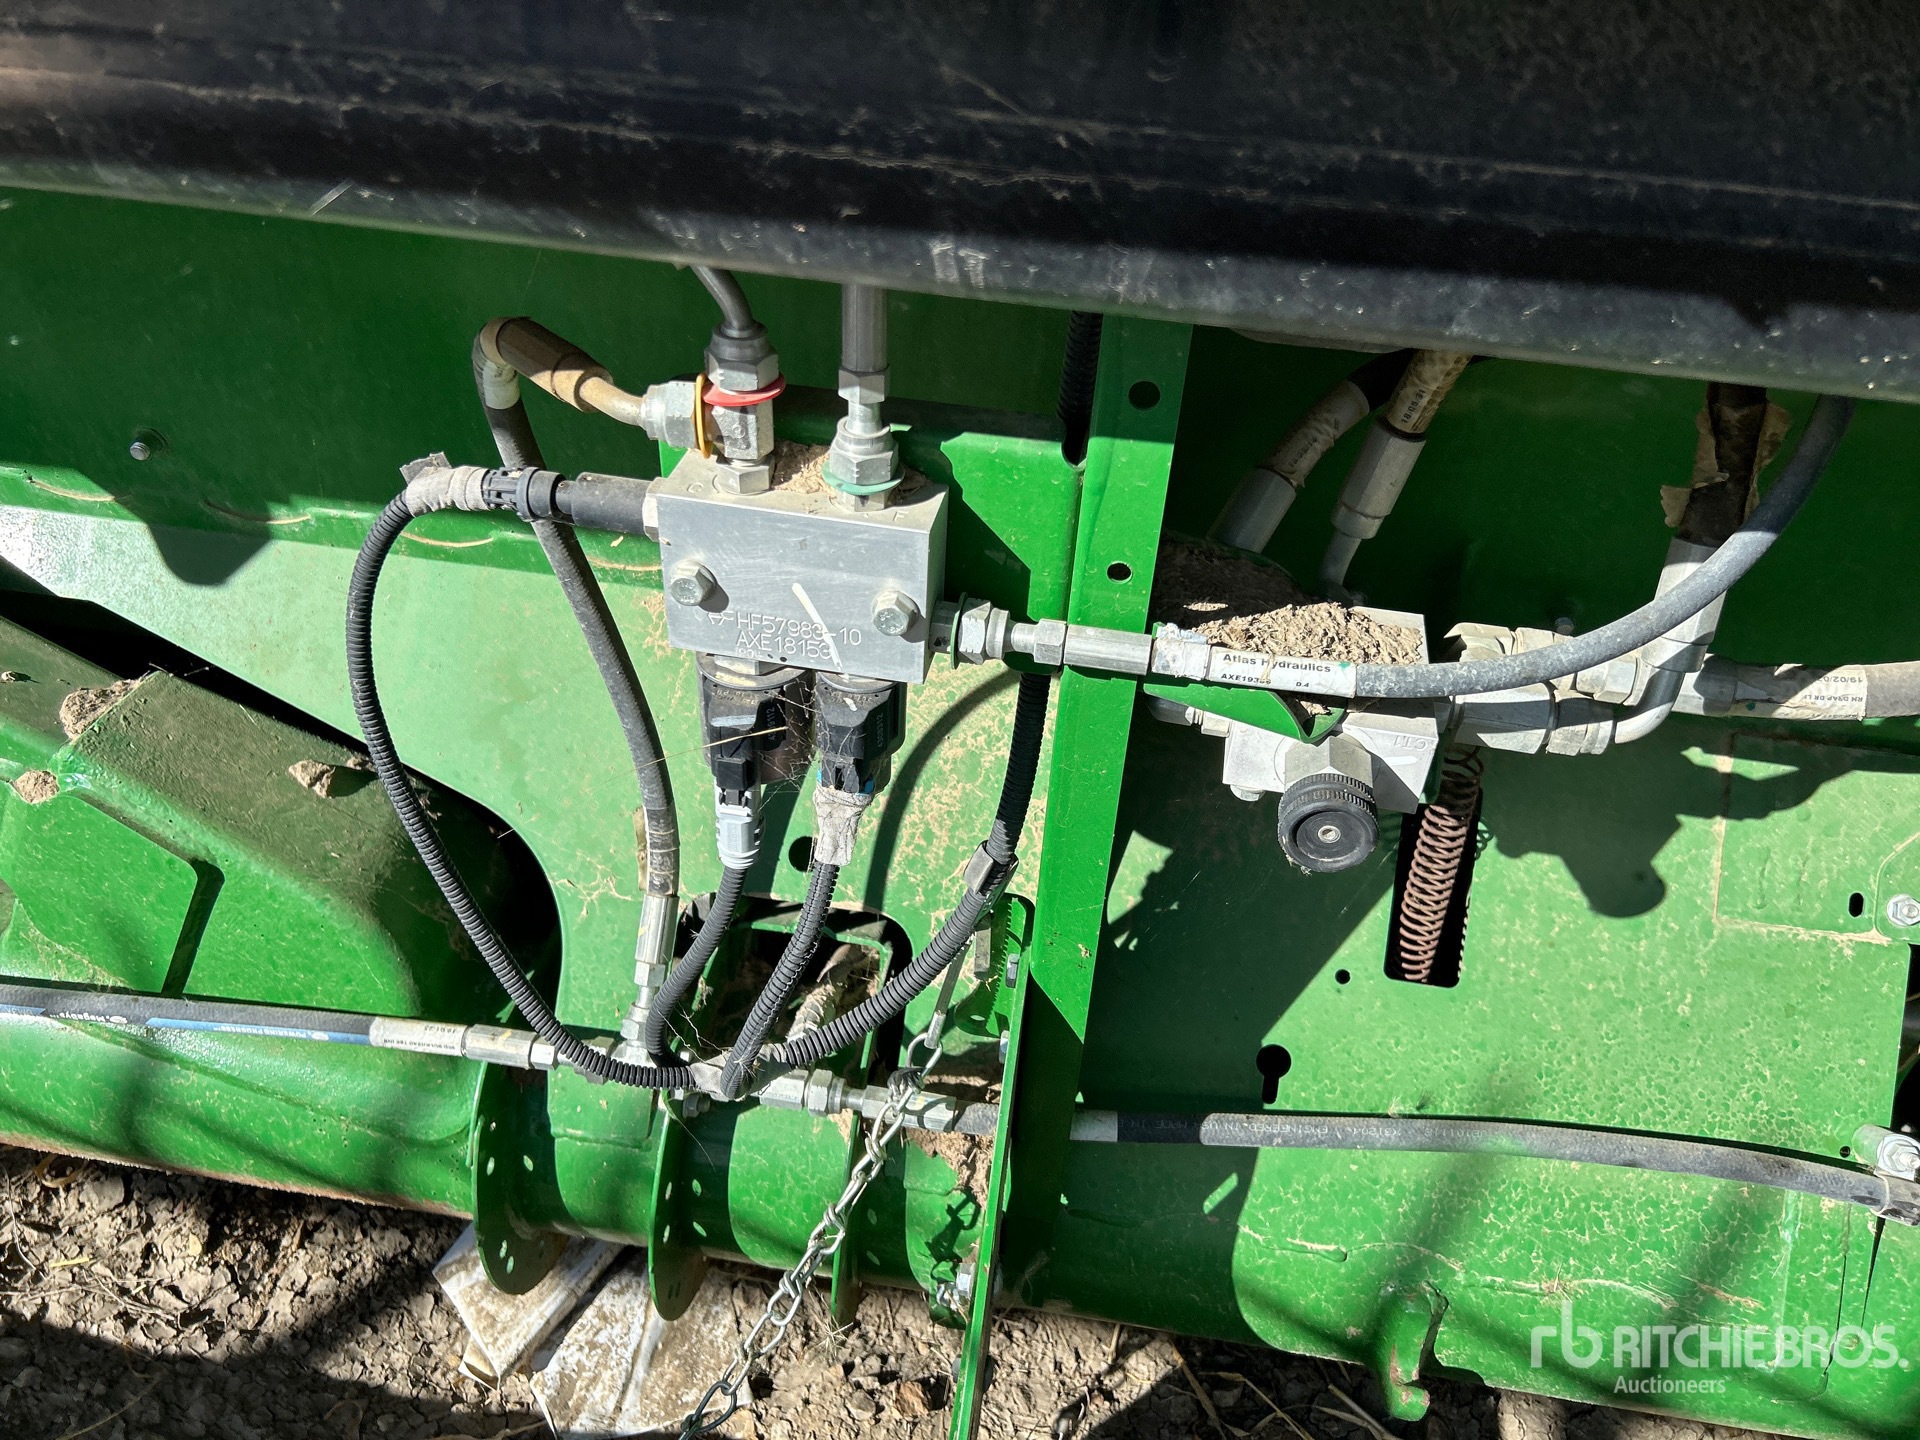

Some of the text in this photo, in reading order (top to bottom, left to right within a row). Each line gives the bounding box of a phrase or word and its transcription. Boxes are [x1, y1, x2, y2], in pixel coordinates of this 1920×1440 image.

[1222, 653, 1331, 673] Atlas Hydraulics
[1248, 1122, 1329, 1135] ENGINEERED
